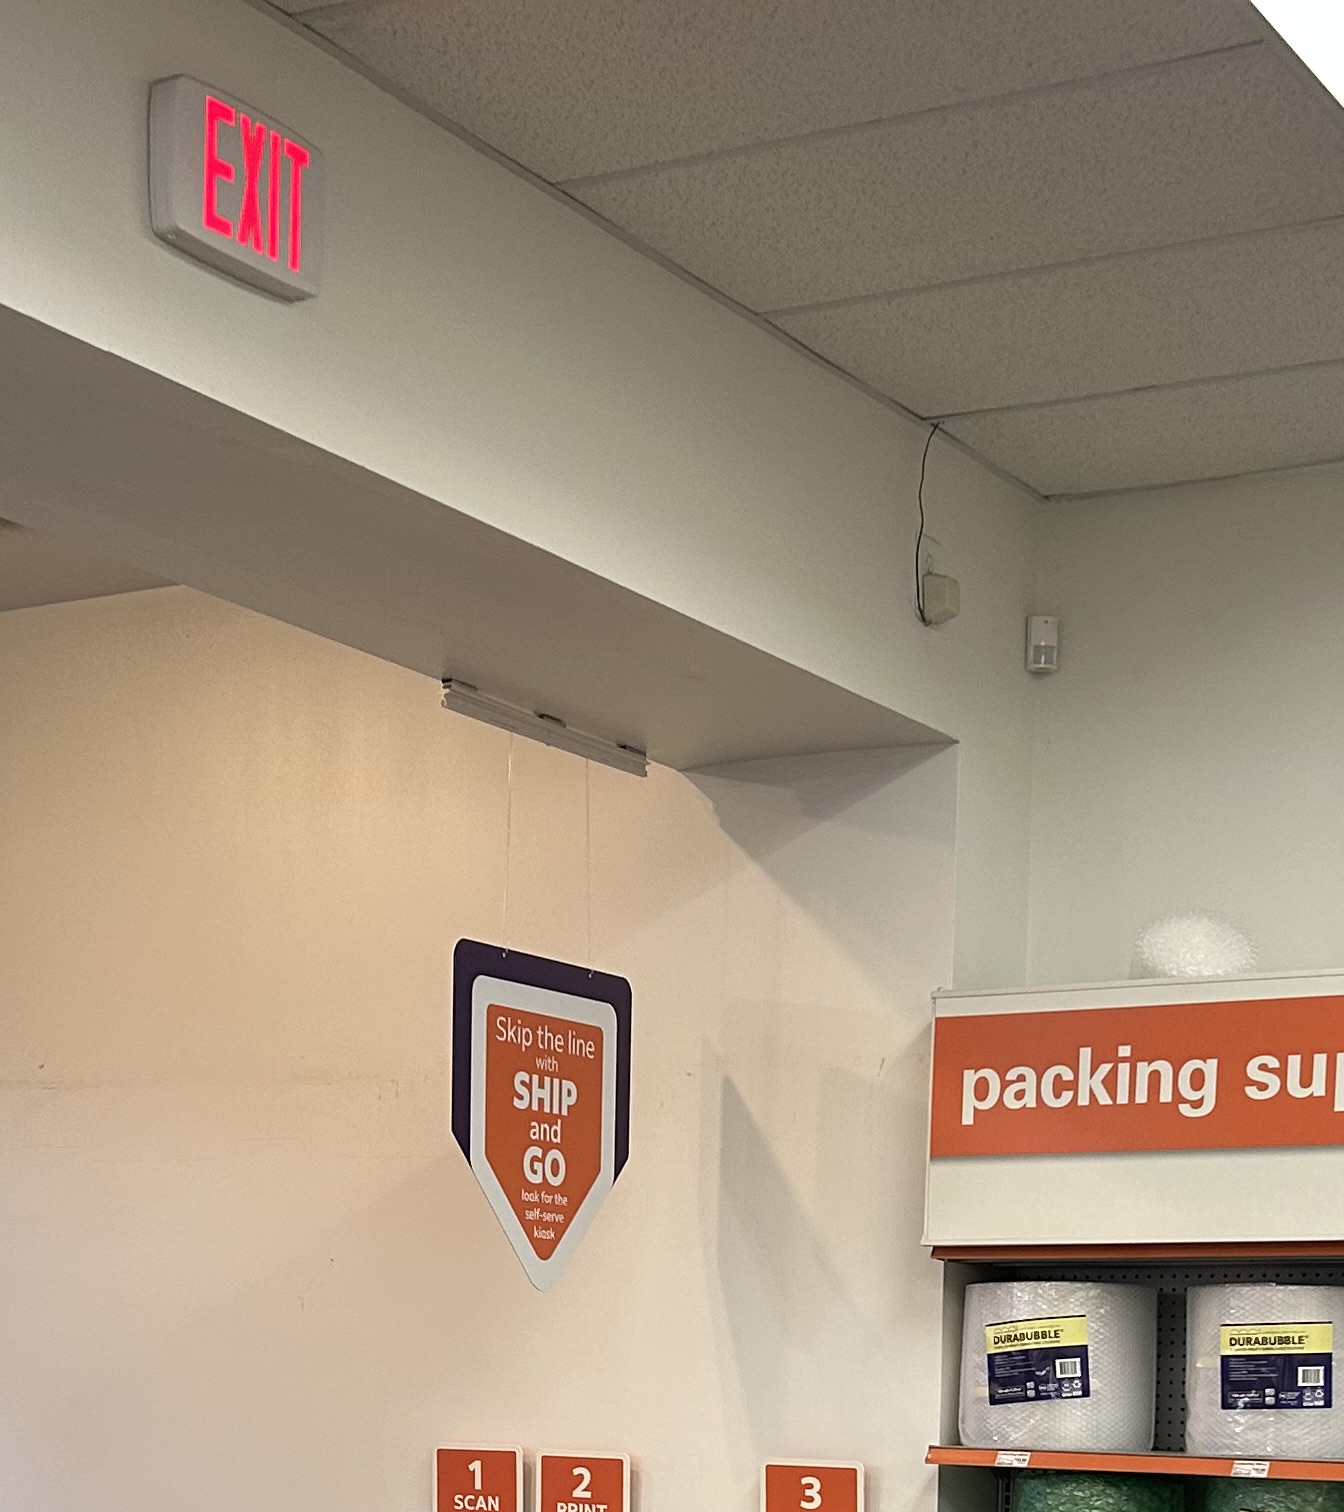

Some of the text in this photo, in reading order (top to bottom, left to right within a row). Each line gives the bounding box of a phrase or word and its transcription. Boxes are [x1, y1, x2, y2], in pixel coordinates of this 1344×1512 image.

[202, 95, 310, 273] EXIT
[496, 1015, 596, 1060] Skip the line
[535, 1055, 559, 1072] with
[513, 1070, 578, 1117] SHIP
[961, 1042, 1219, 1125] packing
[529, 1119, 561, 1144] and
[522, 1145, 566, 1186] GO
[521, 1188, 568, 1207] look for the
[525, 1206, 565, 1224] self-serve
[534, 1225, 556, 1241] kiosk
[993, 1329, 1060, 1345] DURABUBBLE
[1229, 1335, 1306, 1347] DURABUBBLE
[467, 1460, 482, 1491] 1
[572, 1466, 592, 1499] 2
[453, 1494, 500, 1511] SCAN
[800, 1476, 822, 1510] 3
